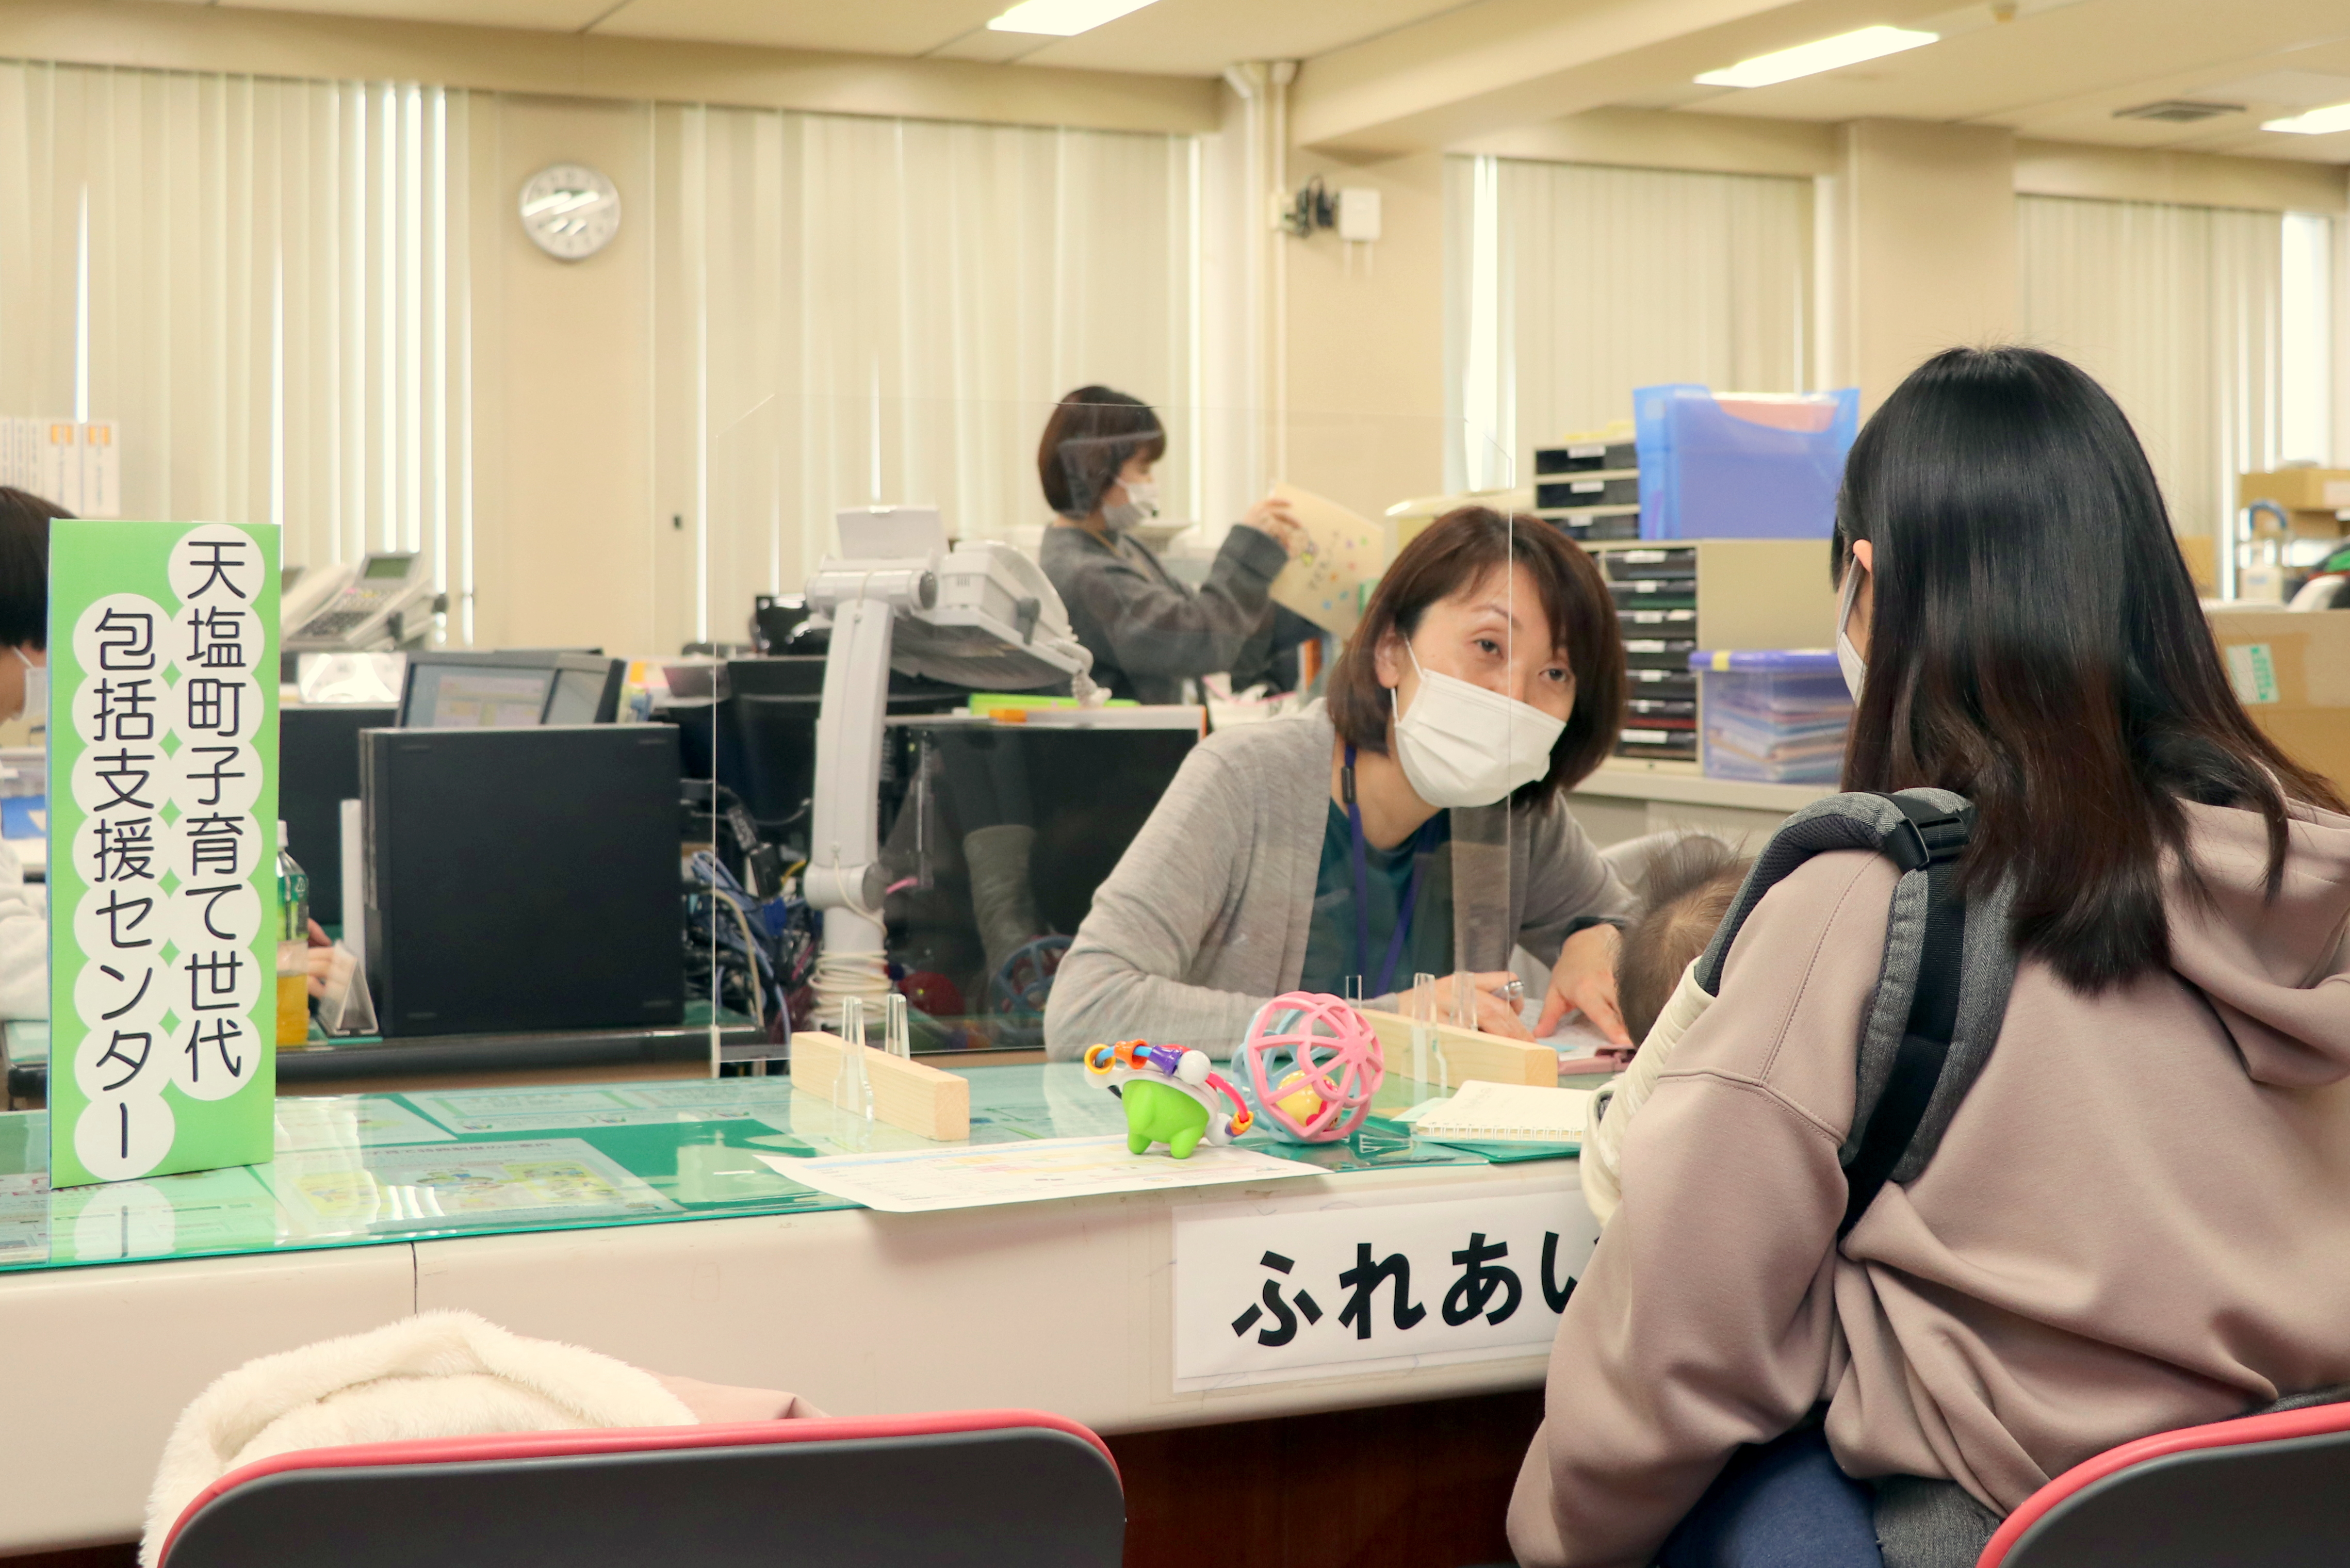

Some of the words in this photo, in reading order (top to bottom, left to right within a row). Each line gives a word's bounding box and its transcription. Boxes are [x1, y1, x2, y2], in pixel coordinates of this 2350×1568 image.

[93, 607, 156, 1159] 包括支援センター
[185, 541, 247, 1082] 天塩町子育て世代
